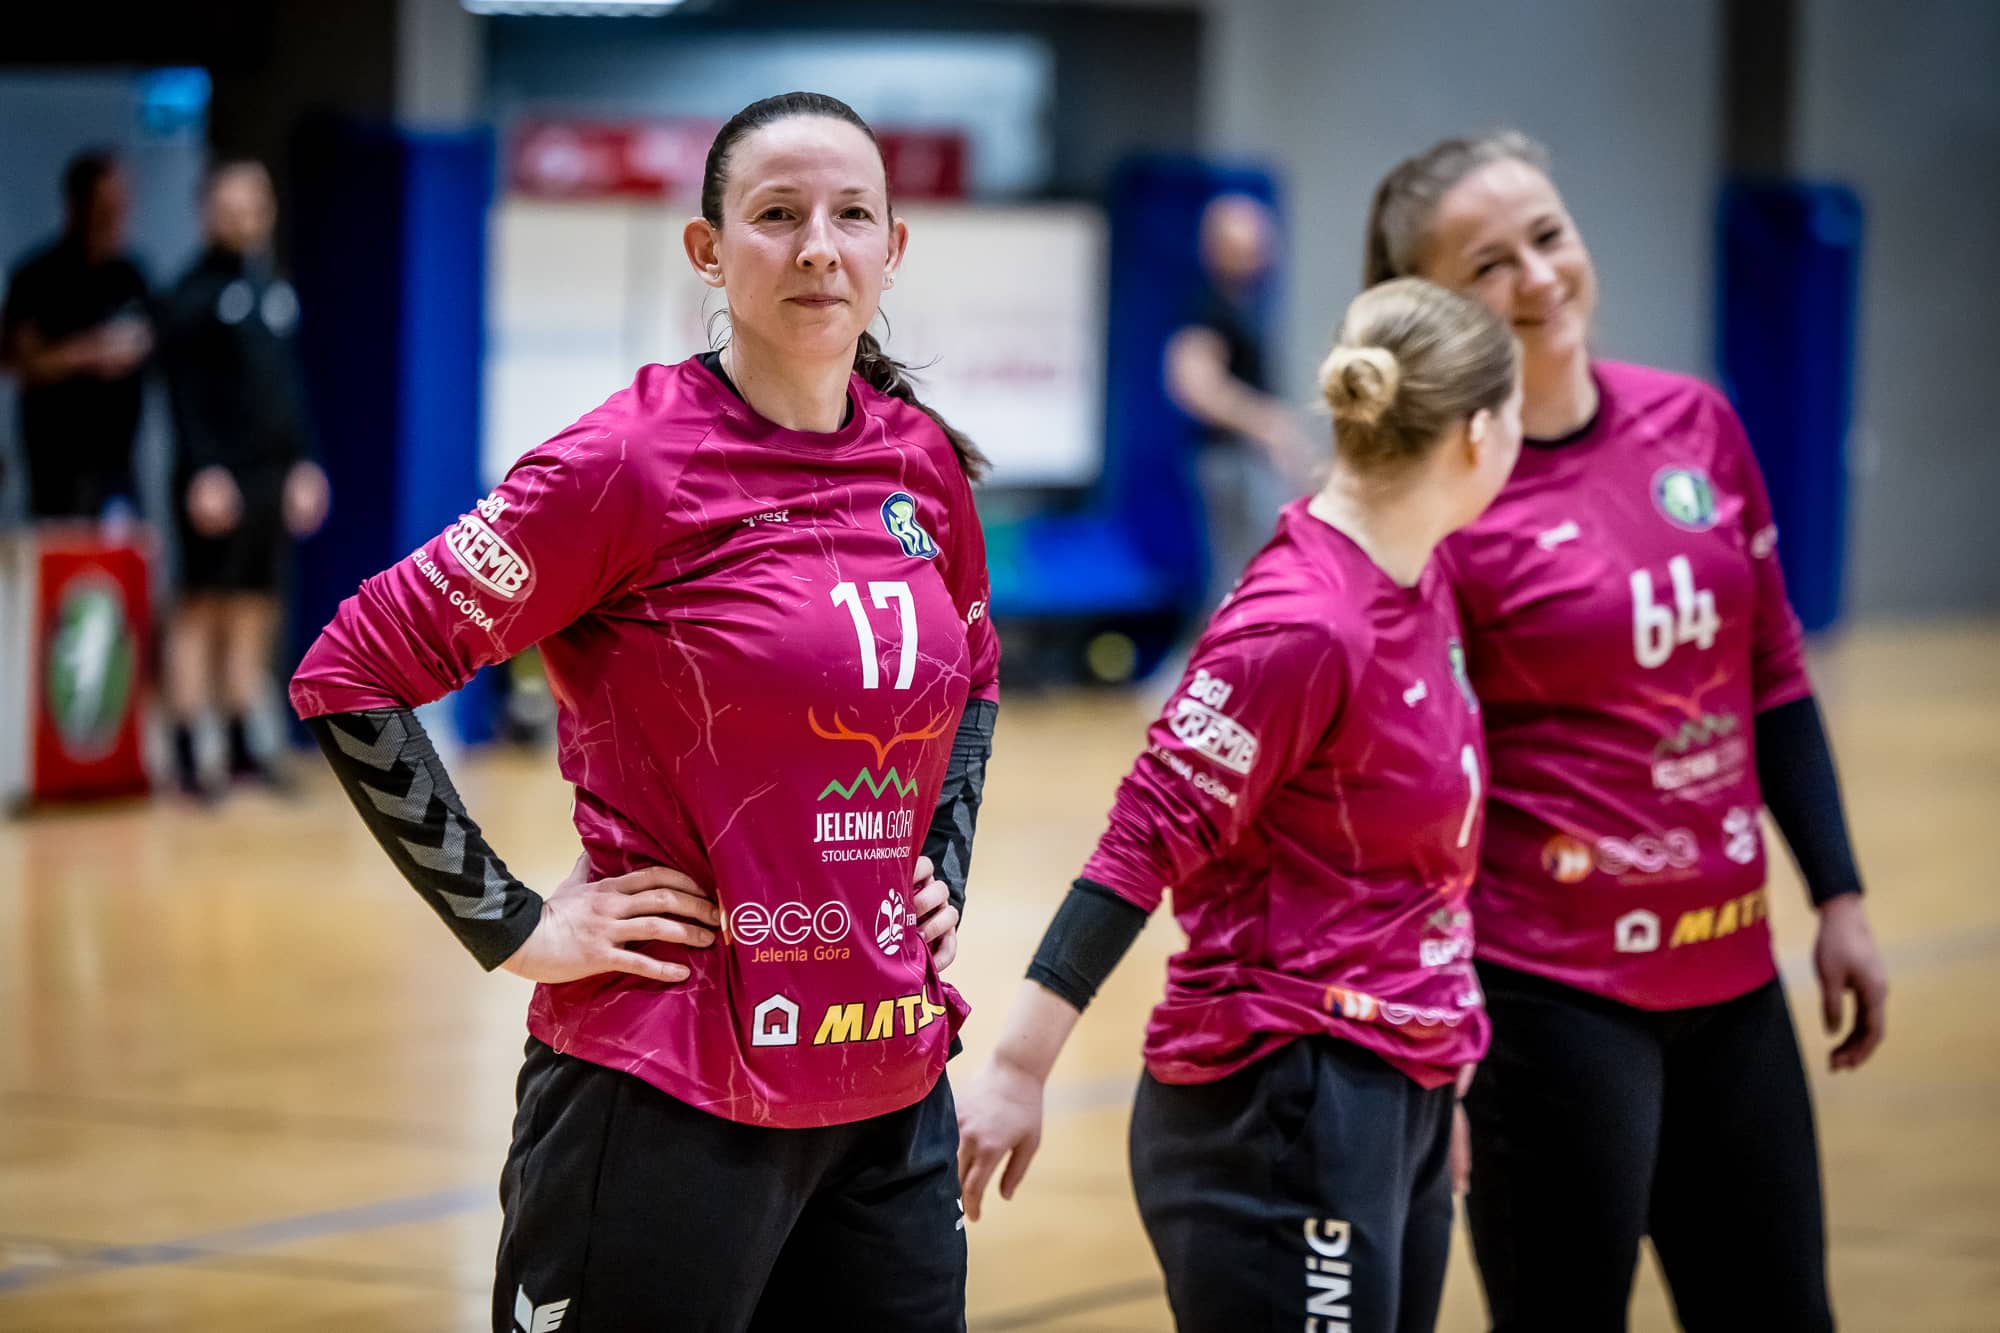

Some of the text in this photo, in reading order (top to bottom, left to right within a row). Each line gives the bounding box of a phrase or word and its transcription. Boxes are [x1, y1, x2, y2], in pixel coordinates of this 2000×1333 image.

[449, 590, 494, 632] GÓRA
[1630, 555, 1722, 670] 64
[829, 581, 919, 690] 17
[812, 811, 884, 843] JELENIA
[821, 848, 863, 862] STOLICA
[729, 900, 852, 945] eco
[751, 944, 851, 963] Jelenia Góra
